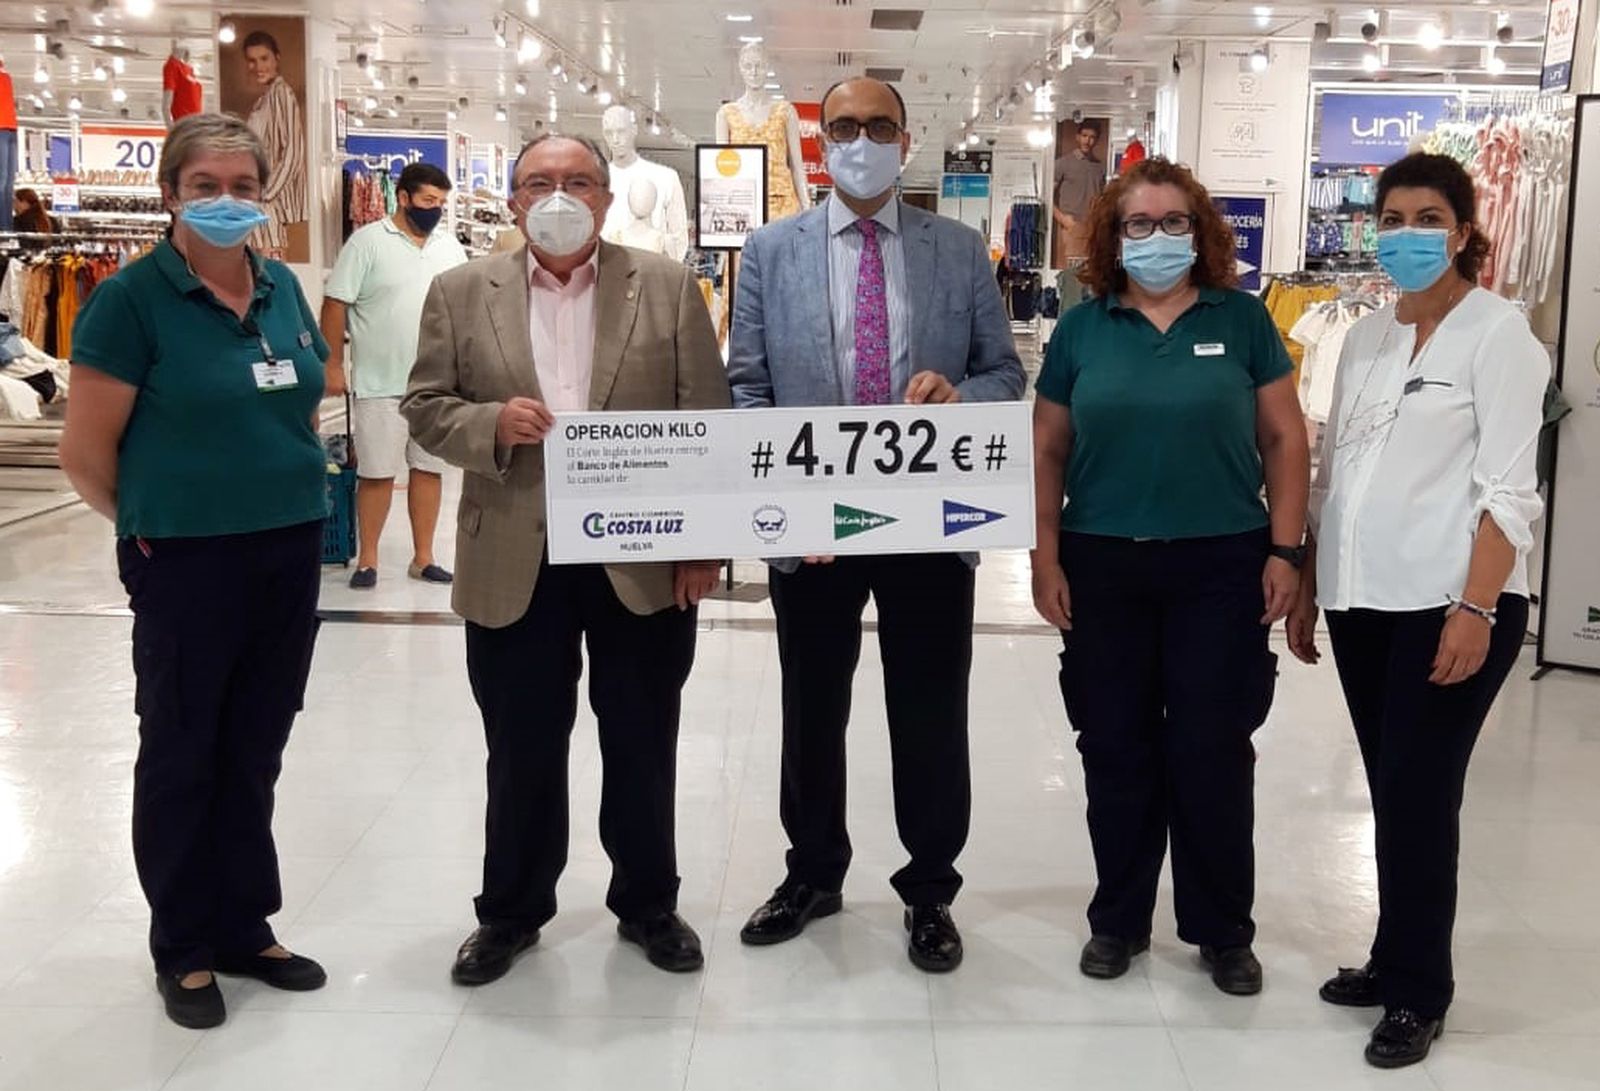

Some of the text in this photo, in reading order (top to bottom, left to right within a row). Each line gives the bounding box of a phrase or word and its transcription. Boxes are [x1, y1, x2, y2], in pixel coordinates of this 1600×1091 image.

[1351, 111, 1424, 137] unit
[115, 140, 162, 168] 20
[565, 422, 707, 441] OPERACION KILO
[786, 418, 938, 477] 4.732
[951, 434, 974, 472] €
[577, 461, 607, 470] Banco
[608, 460, 620, 470] de
[622, 459, 669, 468] Alimentos
[607, 520, 652, 536] COSTA
[655, 518, 684, 534] LUZ
